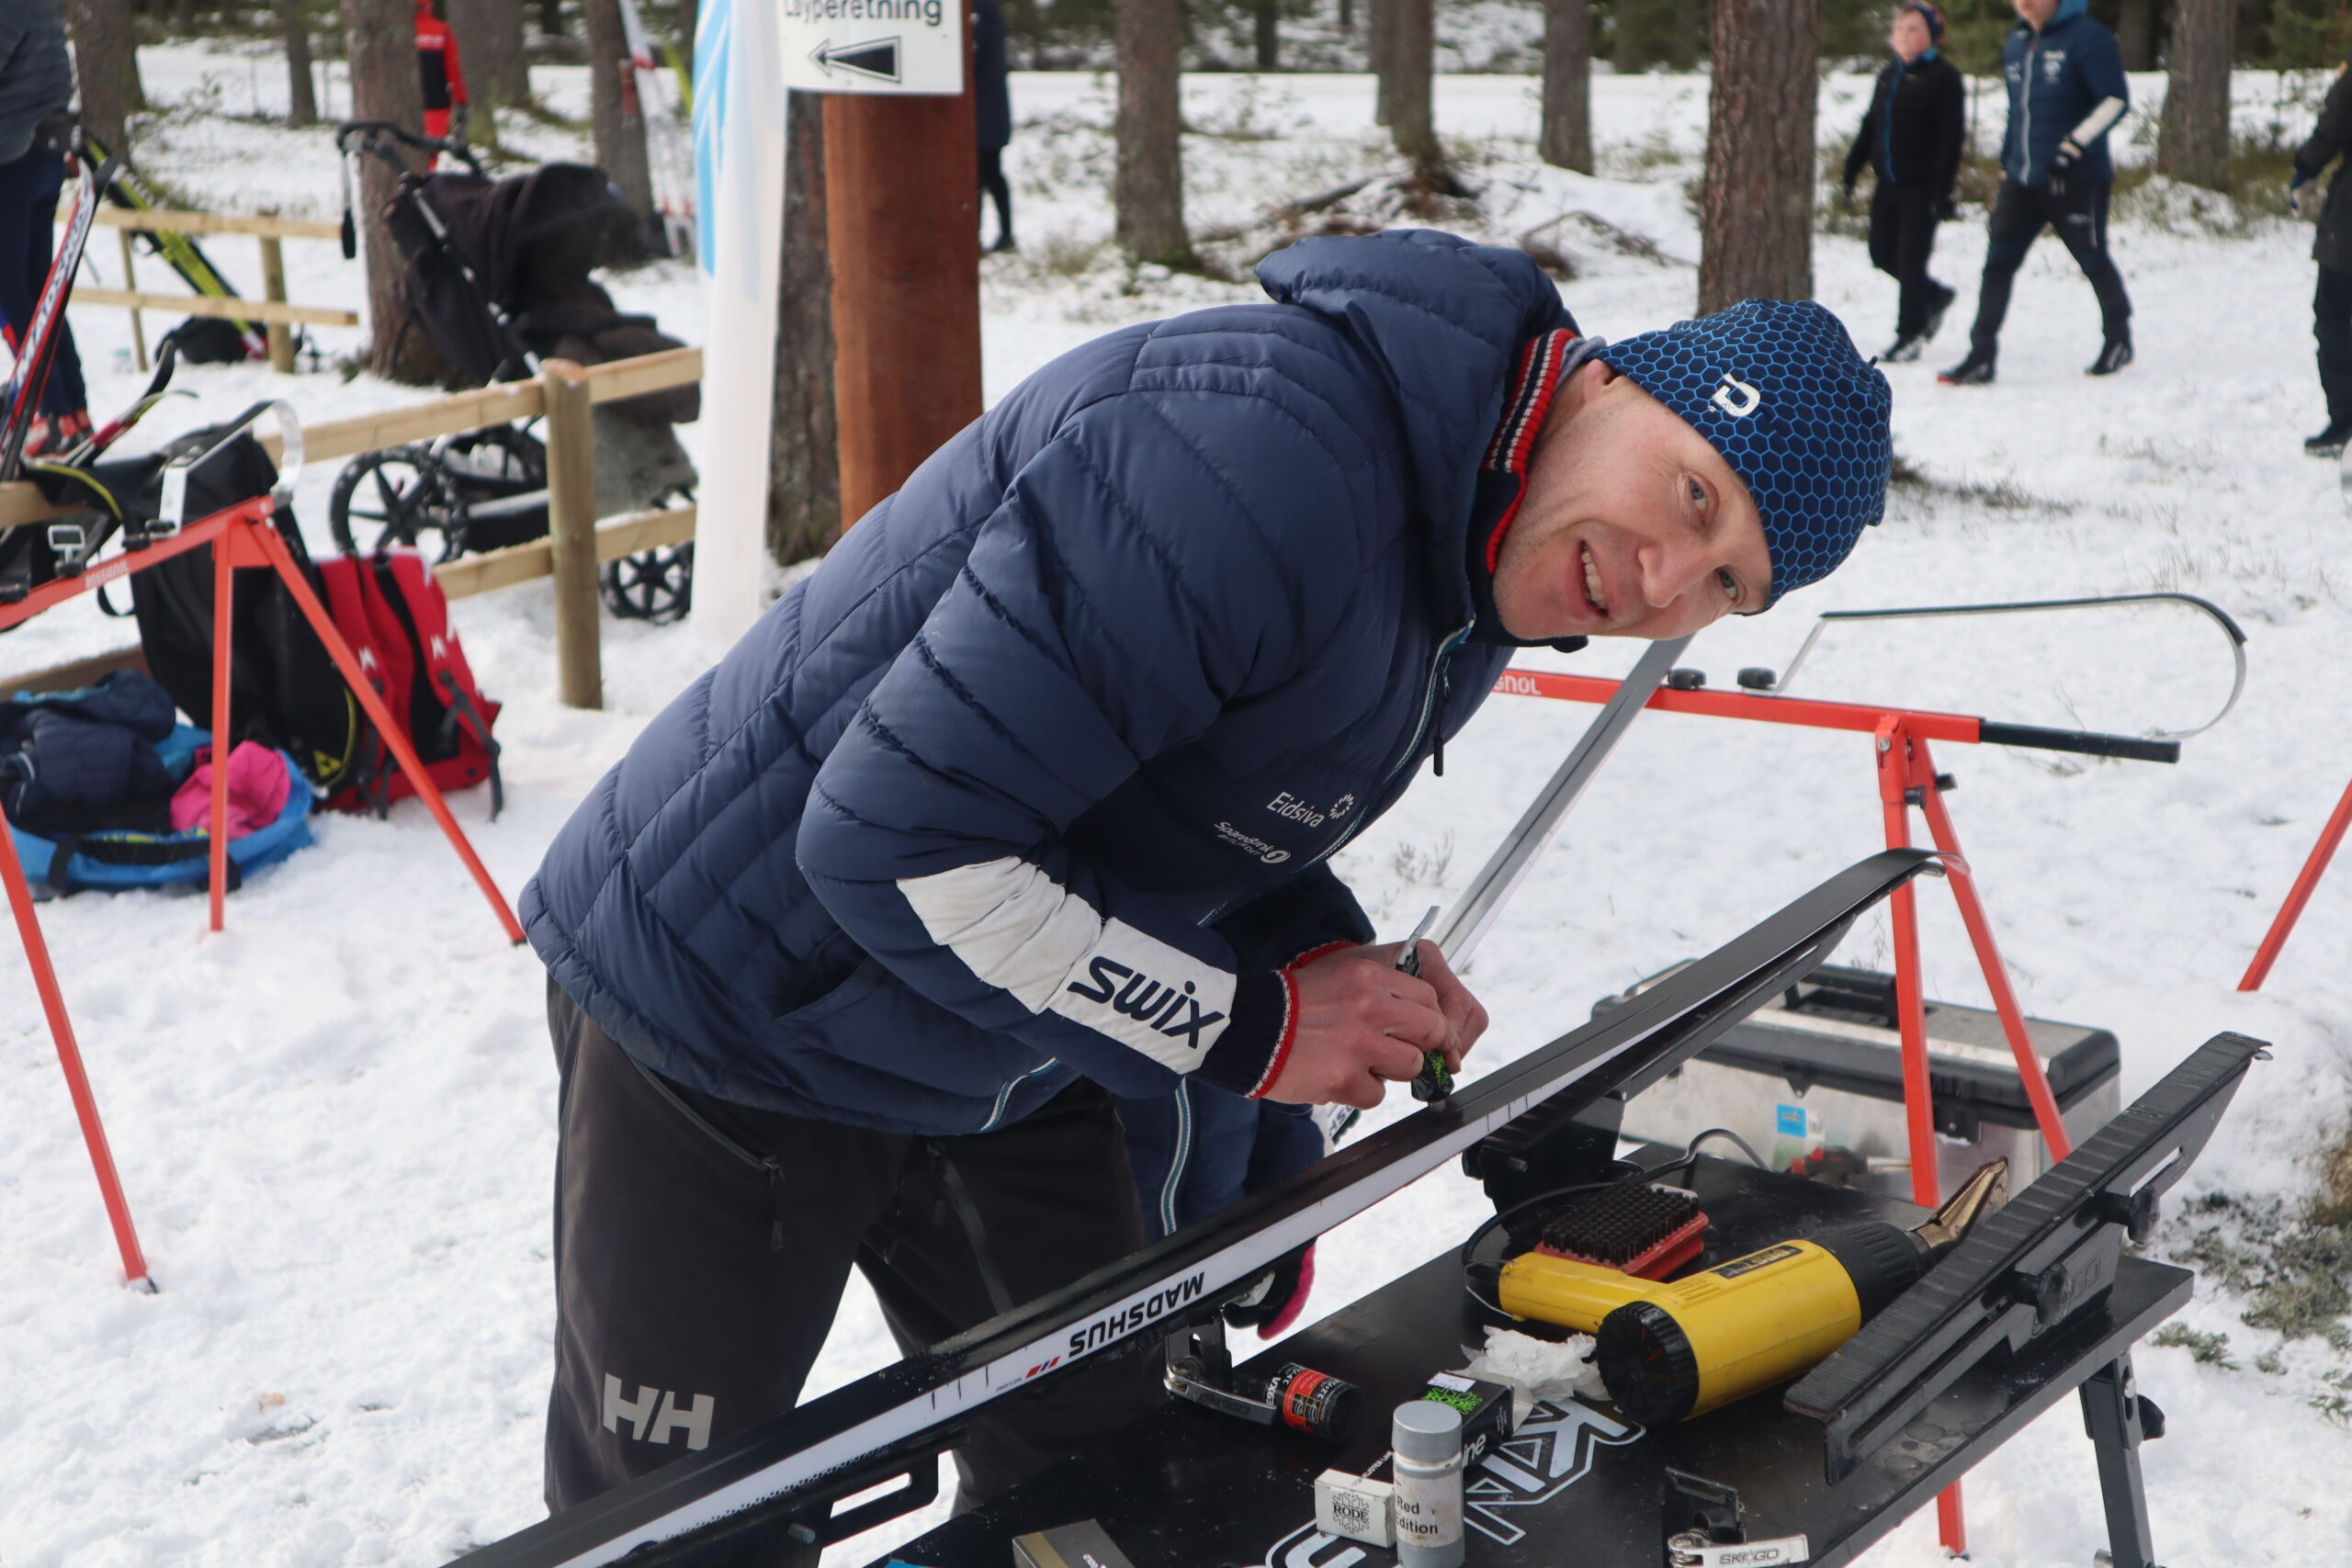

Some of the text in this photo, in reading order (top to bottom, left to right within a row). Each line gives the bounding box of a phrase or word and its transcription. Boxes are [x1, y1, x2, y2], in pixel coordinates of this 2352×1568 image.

[1266, 792, 1325, 828] Eidsiva
[1069, 1271, 1204, 1358] MADSHUS
[1332, 1504, 1370, 1521] RODE
[1396, 1495, 1420, 1516] Red
